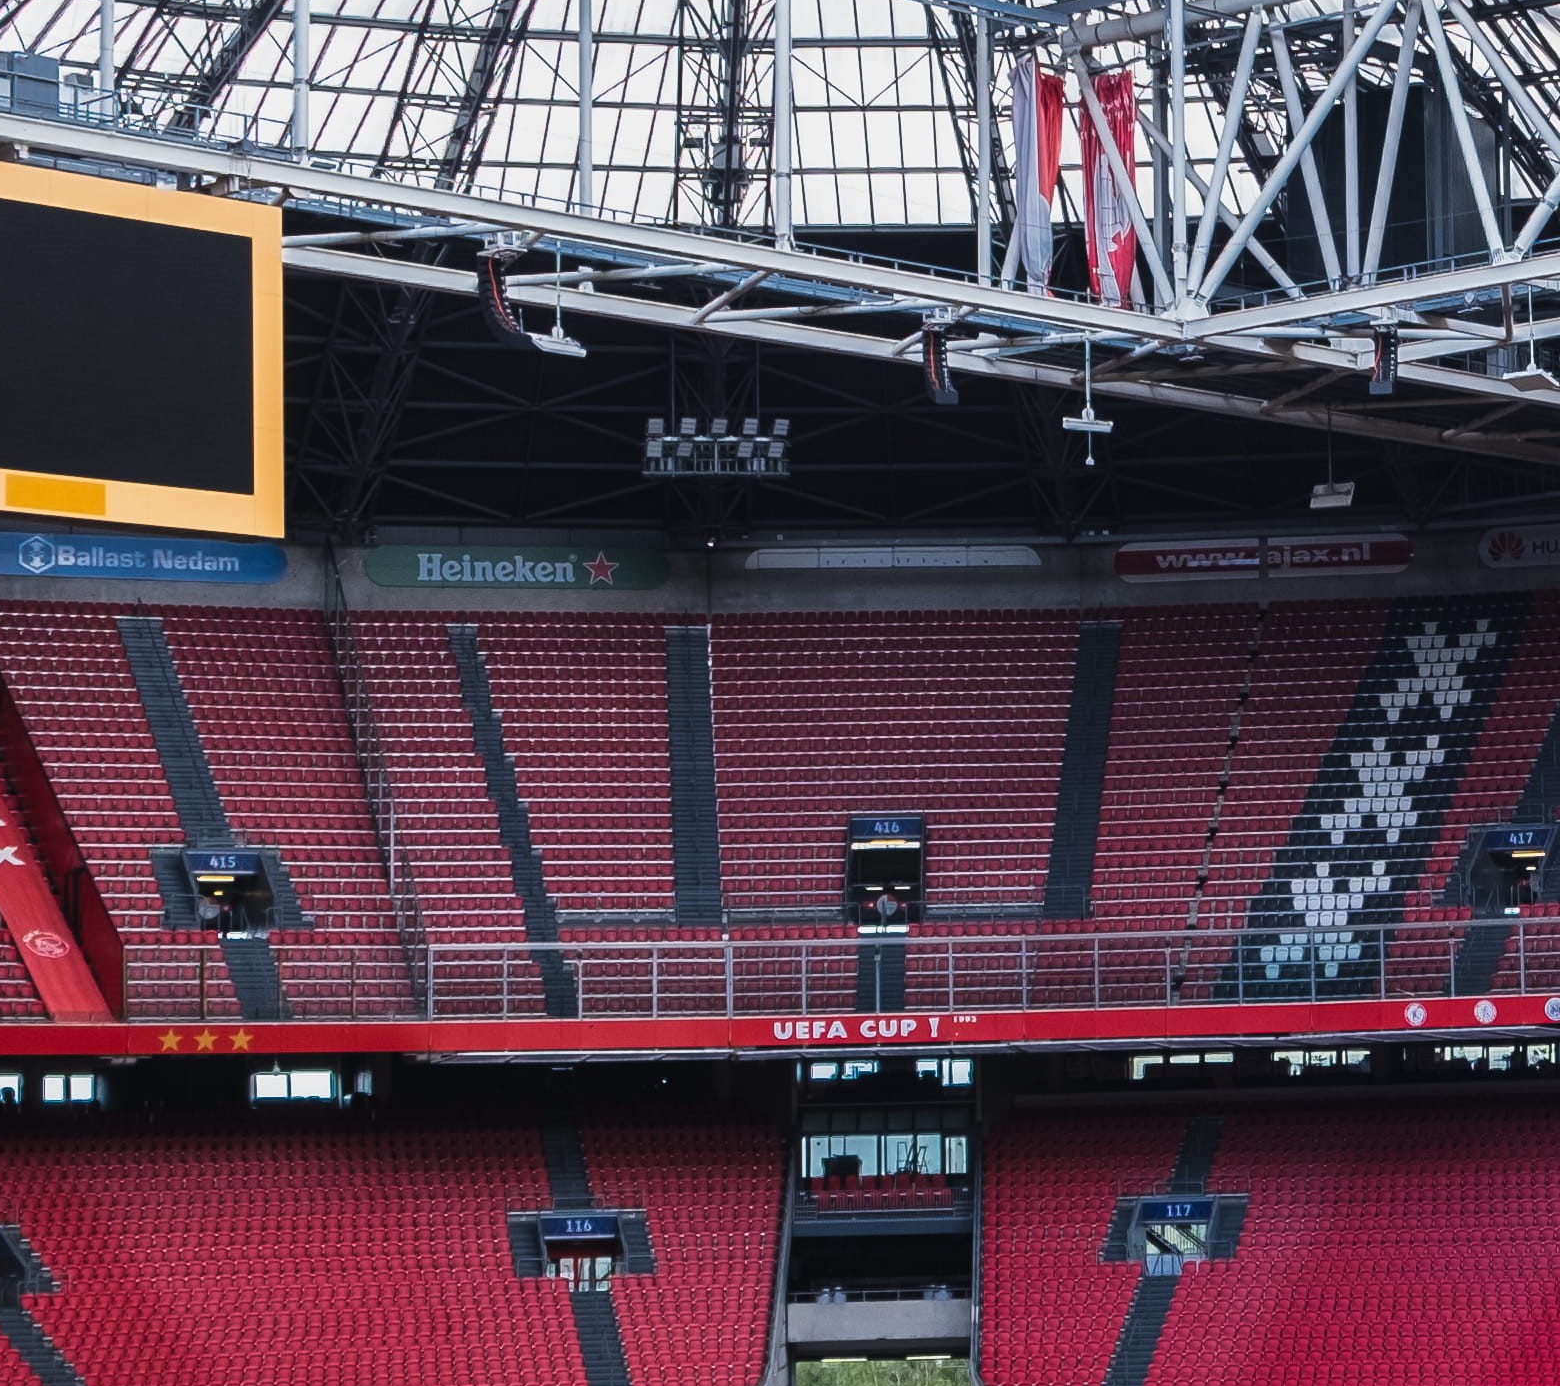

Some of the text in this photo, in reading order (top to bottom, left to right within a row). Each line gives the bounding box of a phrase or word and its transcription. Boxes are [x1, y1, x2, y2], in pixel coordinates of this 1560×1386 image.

[57, 545, 240, 573] Ballast Nedam
[873, 821, 899, 834] 416
[1509, 832, 1533, 845] 417
[209, 856, 236, 868] 415
[773, 1019, 917, 1040] UEFA CUP
[1167, 1204, 1191, 1217] 117
[565, 1219, 591, 1233] 116
